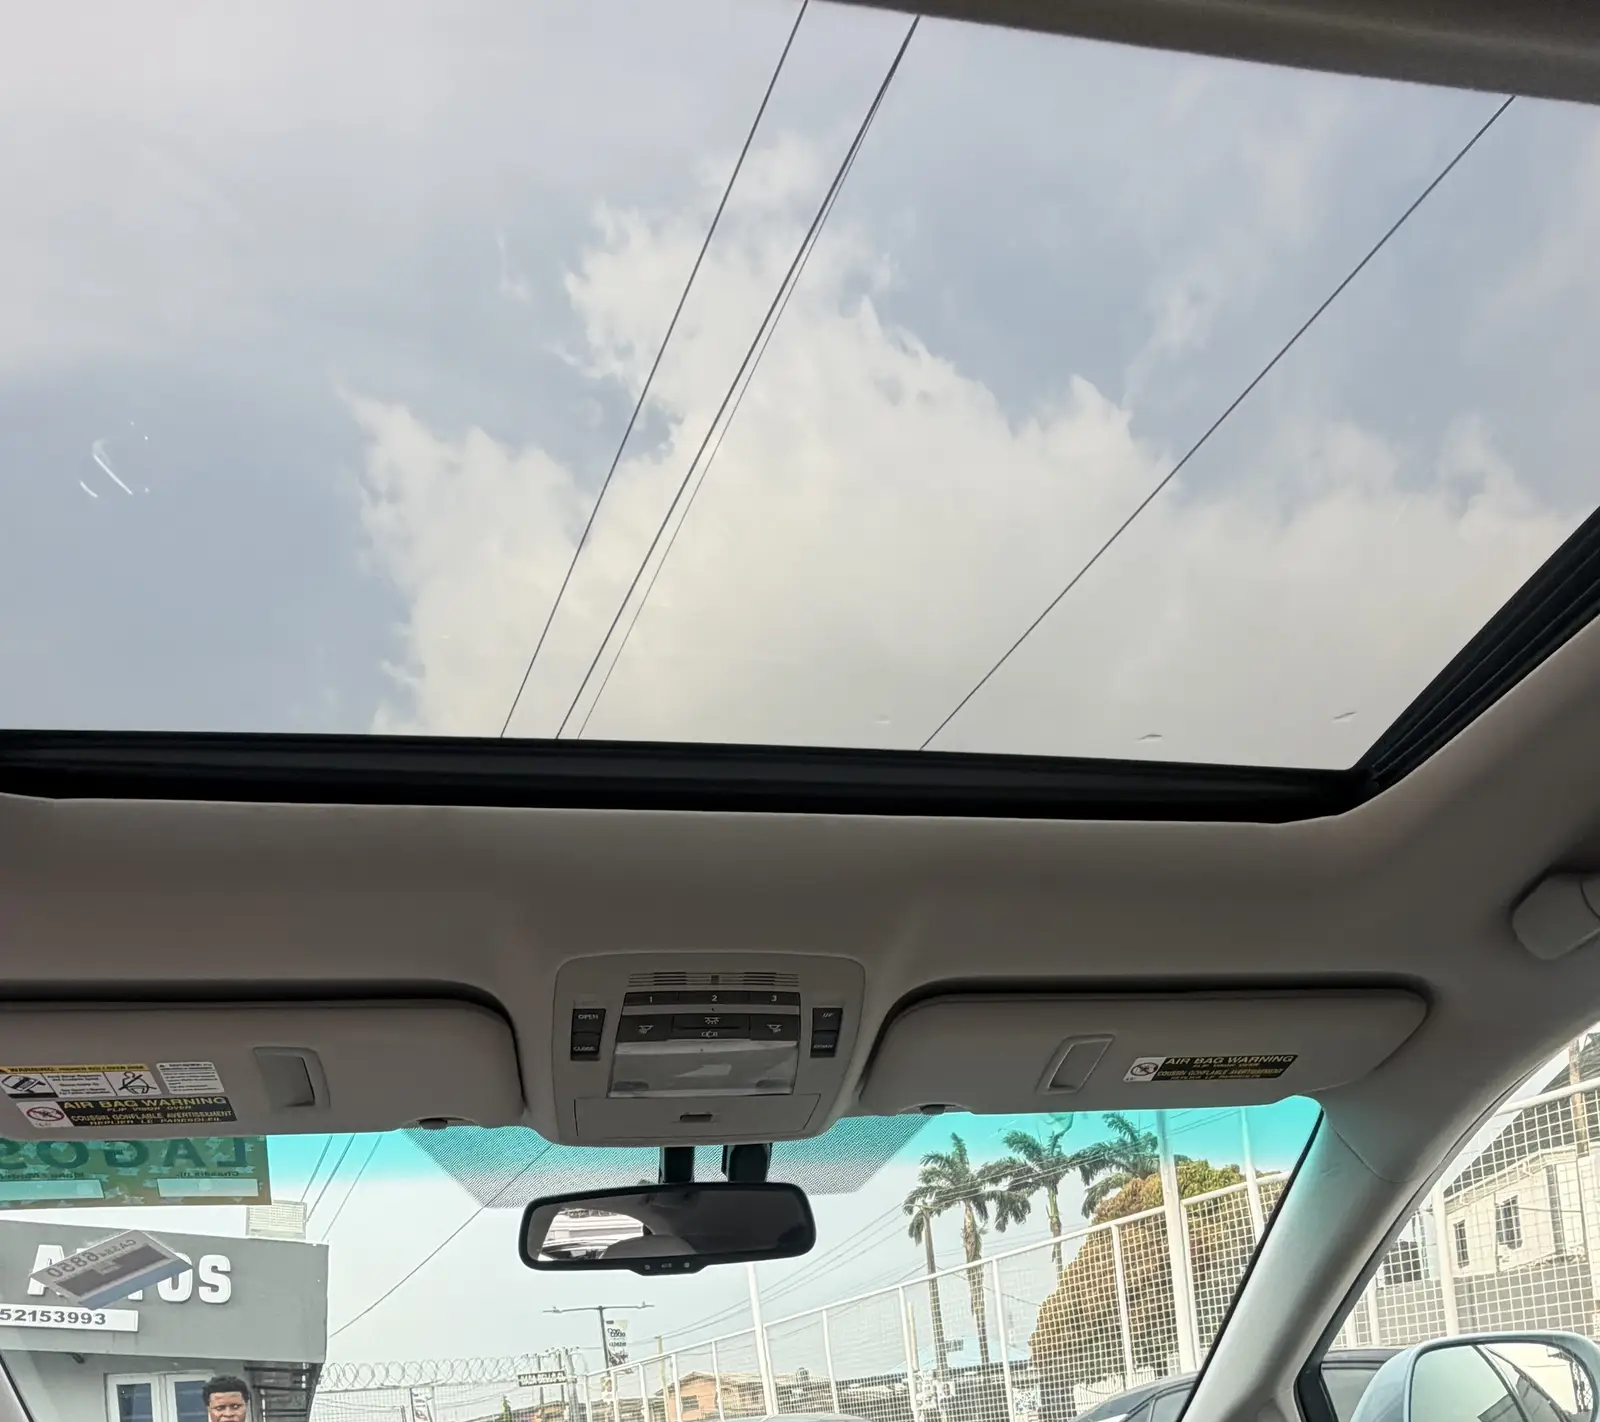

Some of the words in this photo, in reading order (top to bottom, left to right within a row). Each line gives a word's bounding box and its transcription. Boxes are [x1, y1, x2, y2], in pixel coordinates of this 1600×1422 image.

[711, 994, 718, 1002] 2
[771, 994, 778, 1002] 3
[1197, 1056, 1224, 1064] BAG
[1227, 1055, 1294, 1063] WARNING
[64, 1101, 95, 1110] AIR
[100, 1099, 139, 1109] BAG
[140, 1096, 228, 1107] WARNING
